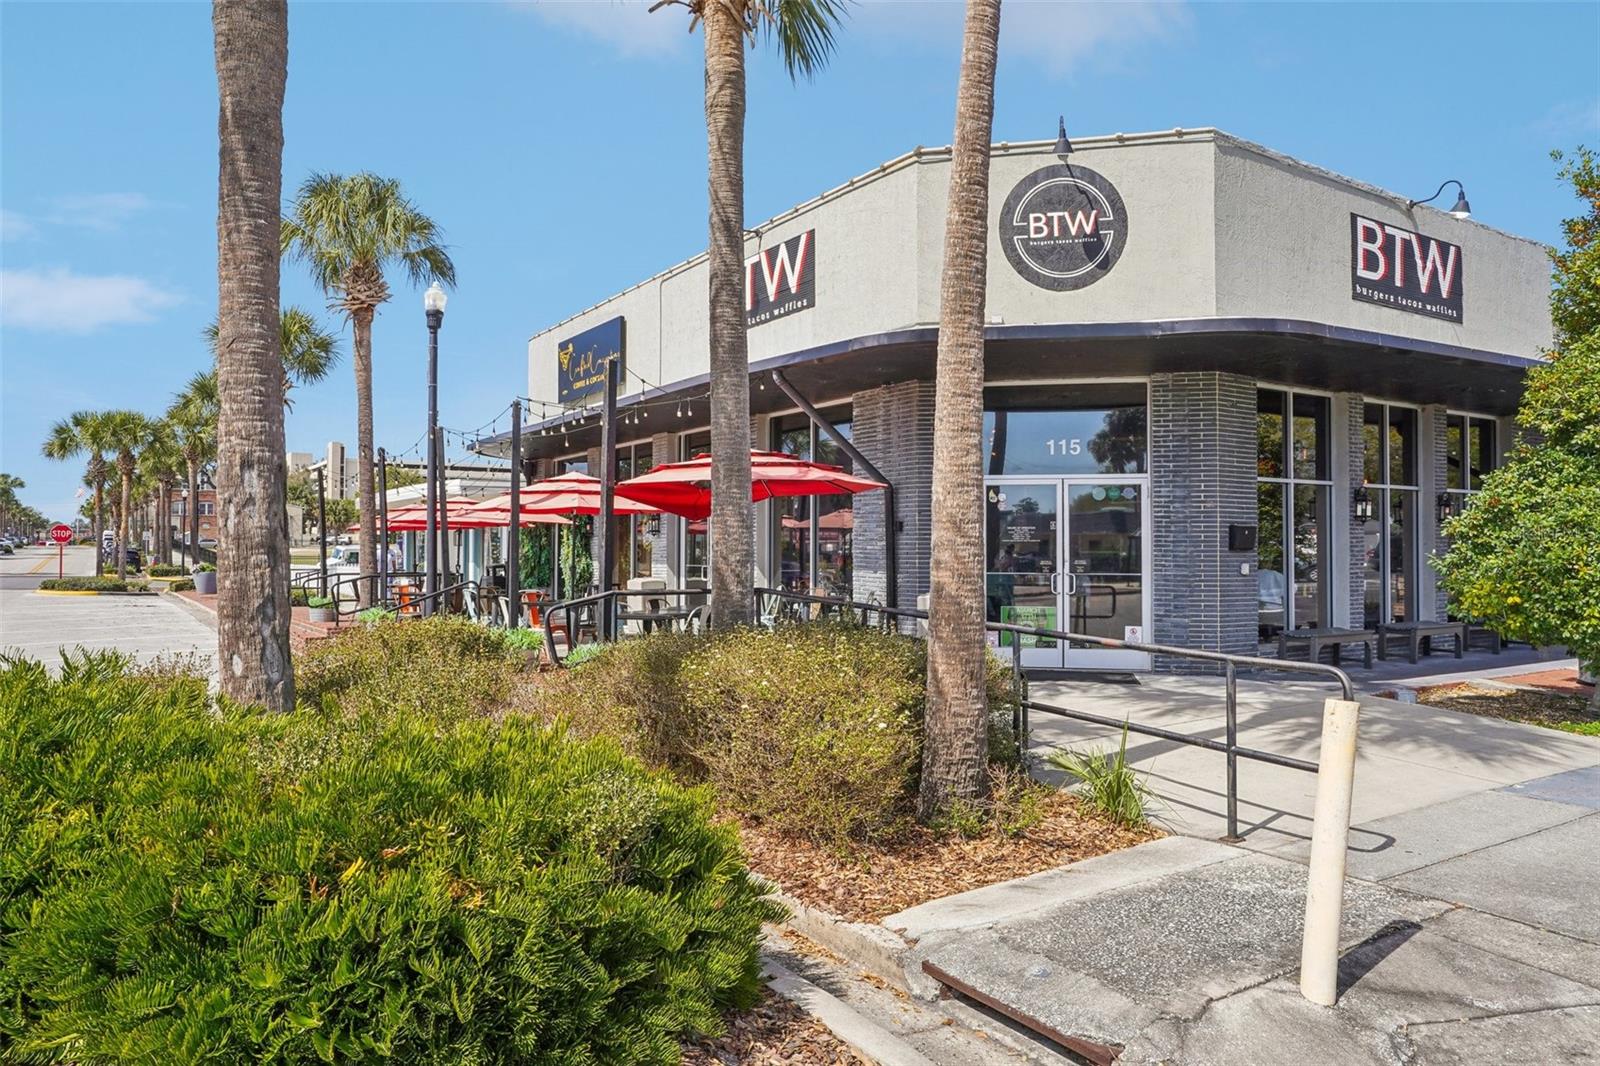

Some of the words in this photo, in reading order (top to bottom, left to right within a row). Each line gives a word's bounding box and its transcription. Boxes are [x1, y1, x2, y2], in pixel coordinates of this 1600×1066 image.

[1029, 209, 1098, 239] BTW
[744, 231, 811, 312] TW
[1356, 216, 1458, 299] BTW
[748, 312, 770, 326] tacos
[773, 298, 808, 316] waffles
[1355, 284, 1395, 302] burgers
[1398, 295, 1422, 309] tacos
[1425, 304, 1457, 317] waffles
[1046, 439, 1081, 455] 115
[52, 530, 72, 538] STOP
